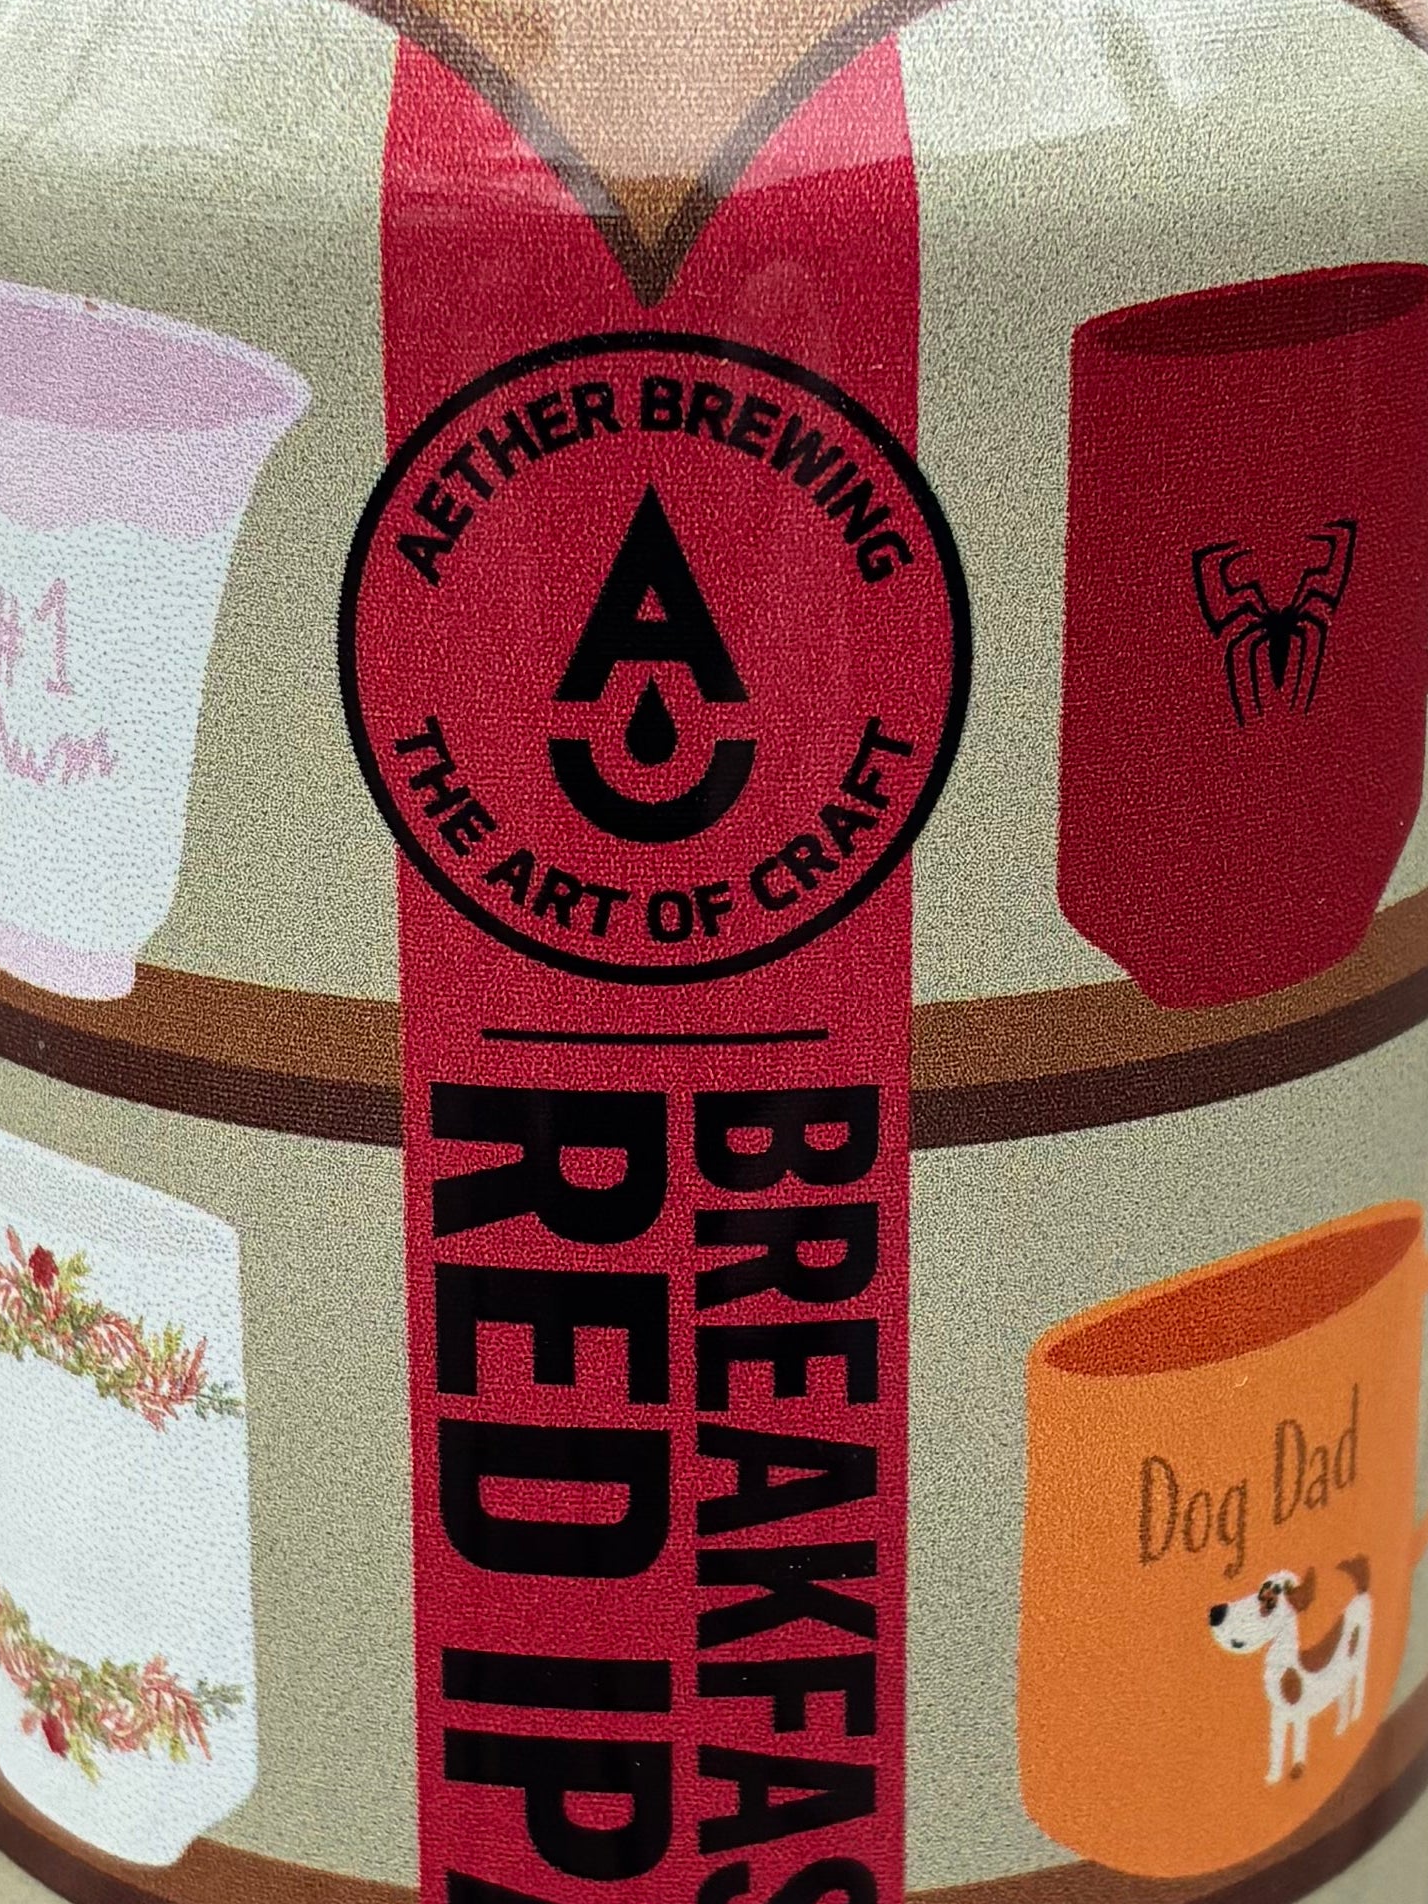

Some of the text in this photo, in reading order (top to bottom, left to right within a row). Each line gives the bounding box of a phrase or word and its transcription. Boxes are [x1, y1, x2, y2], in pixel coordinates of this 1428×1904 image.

[396, 376, 914, 586] AETHER BREWING
[394, 715, 915, 944] THE ART OF CRAFT
[430, 1083, 673, 1580] RED
[1139, 1382, 1359, 1578] Dog Dad
